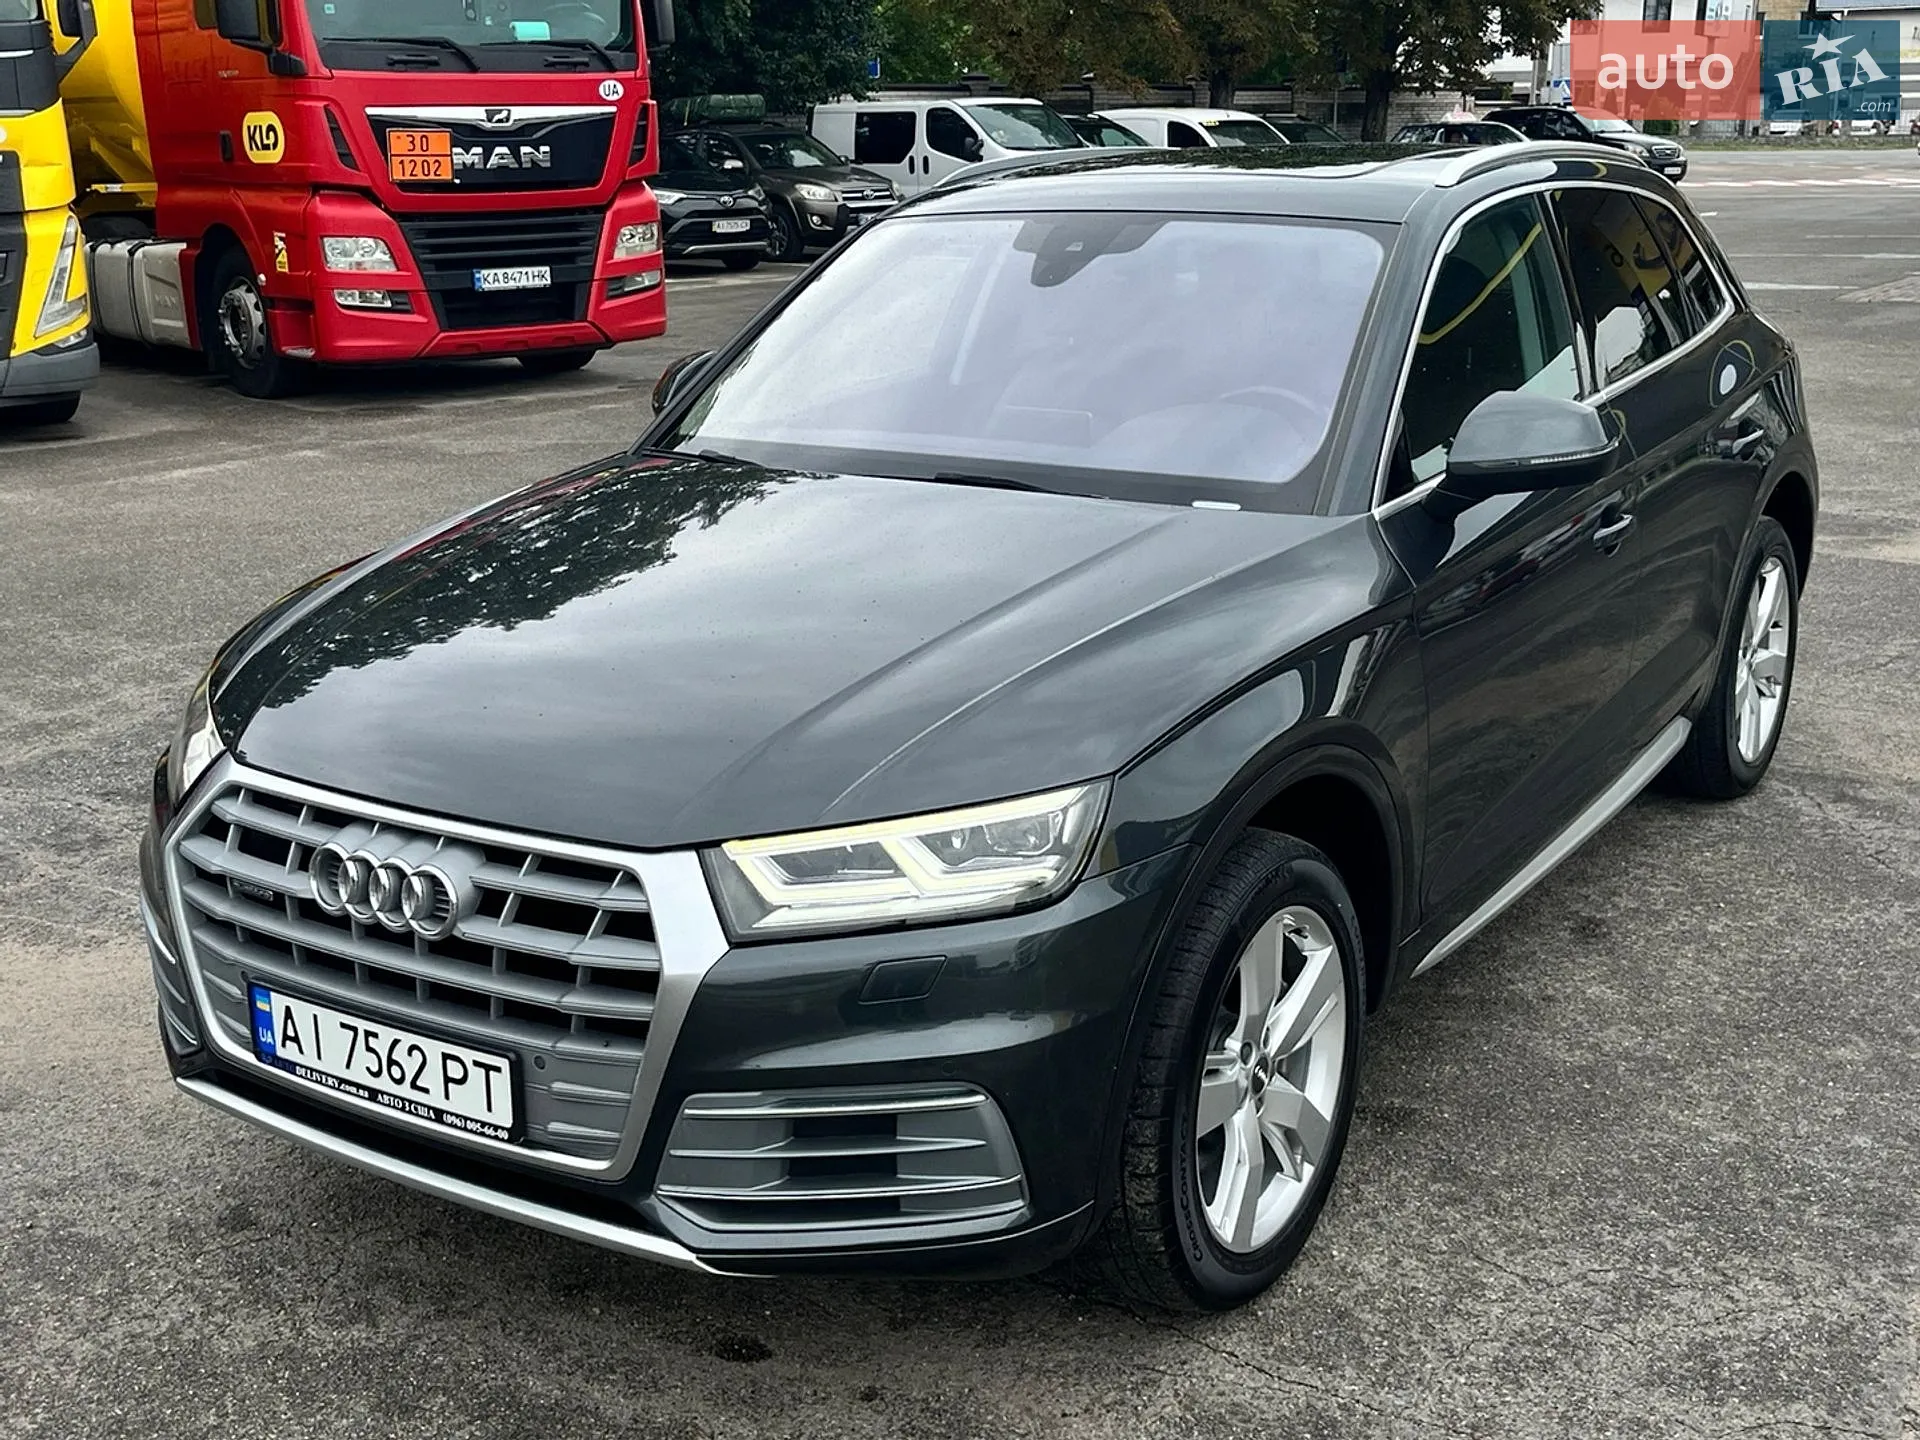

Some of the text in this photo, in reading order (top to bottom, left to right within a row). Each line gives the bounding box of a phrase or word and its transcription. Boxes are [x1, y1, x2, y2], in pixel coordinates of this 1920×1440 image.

[602, 83, 620, 98] UA
[246, 123, 279, 151] KLO
[406, 133, 430, 153] 30
[452, 145, 551, 169] MAN
[398, 159, 442, 178] 1202
[258, 1026, 275, 1046] UA
[280, 1004, 503, 1114] AI 7562 PT
